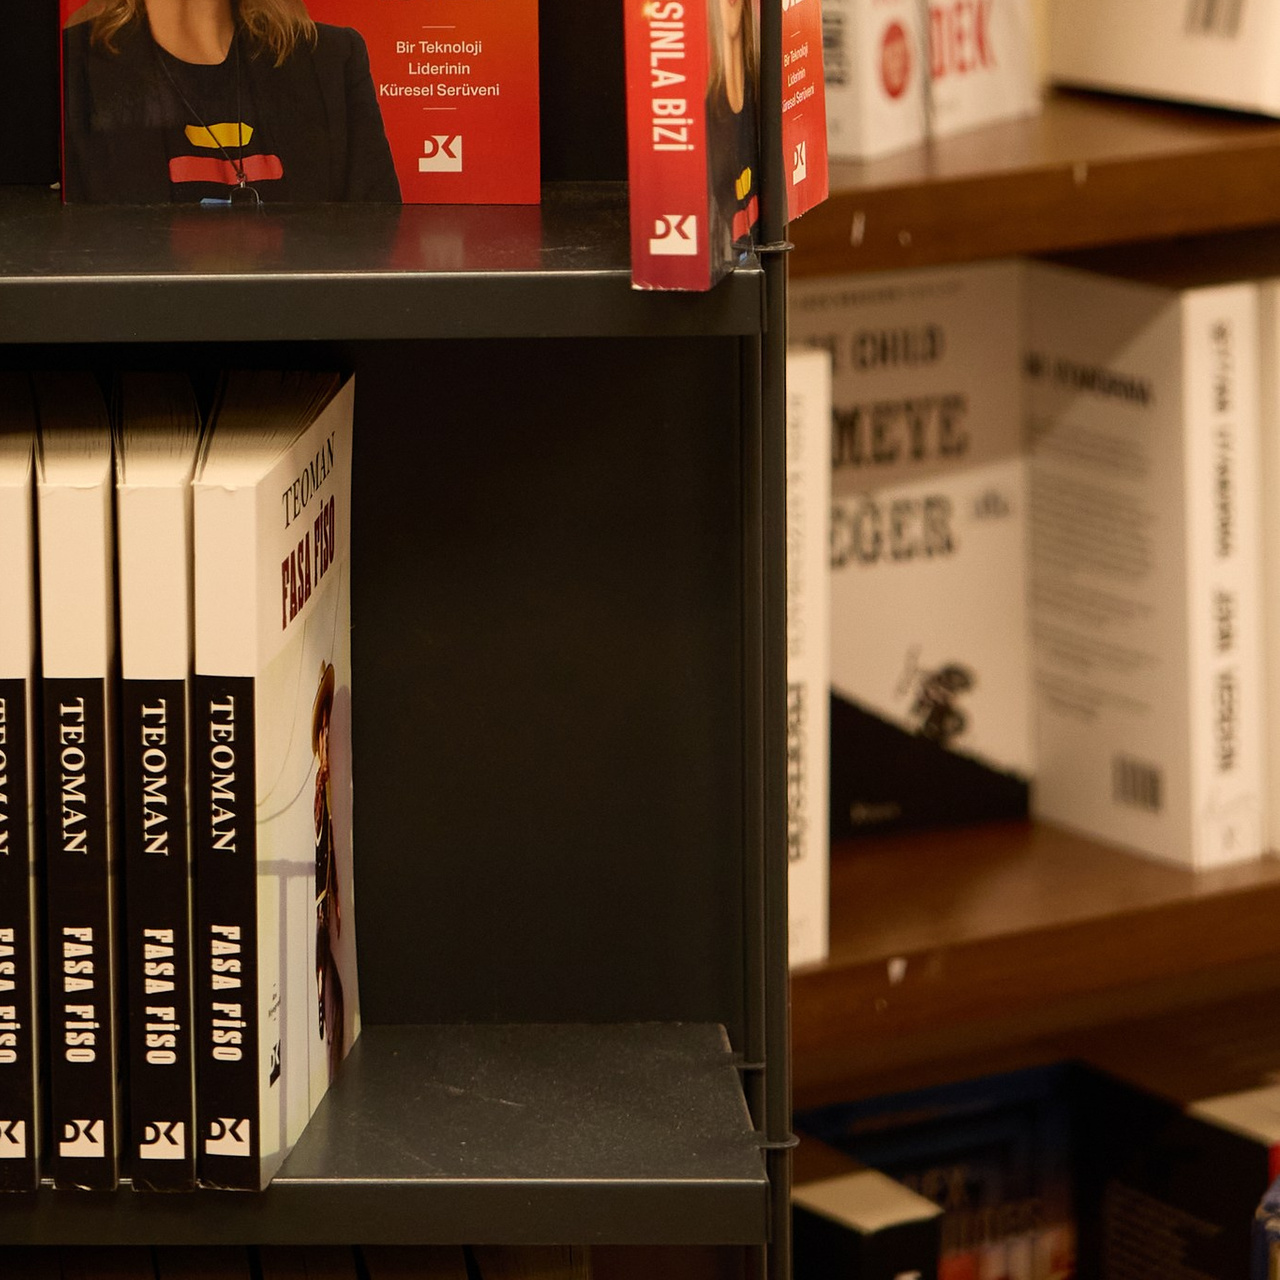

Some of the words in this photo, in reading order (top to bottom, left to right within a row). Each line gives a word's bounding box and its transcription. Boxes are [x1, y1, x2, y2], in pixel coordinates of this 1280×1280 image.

[395, 40, 417, 54] Bir
[419, 40, 483, 58] Teknoloji
[408, 62, 471, 76] Liderinin
[379, 83, 435, 97] Küresel
[437, 83, 500, 97] Serüveni
[651, 97, 695, 153] BİZİ
[282, 431, 335, 530] TEOMAN
[281, 530, 312, 631] FASA
[314, 494, 335, 588] FİSO
[60, 697, 88, 855] TEOMAN
[142, 698, 169, 857] TEOMAN
[210, 695, 236, 853] TEOMAN
[63, 927, 94, 993] FASA
[144, 929, 175, 995] FASA
[211, 925, 242, 990] FASA
[65, 1004, 100, 1063] FİSO
[146, 1006, 180, 1065] FİSO
[213, 1002, 247, 1061] FİSO
